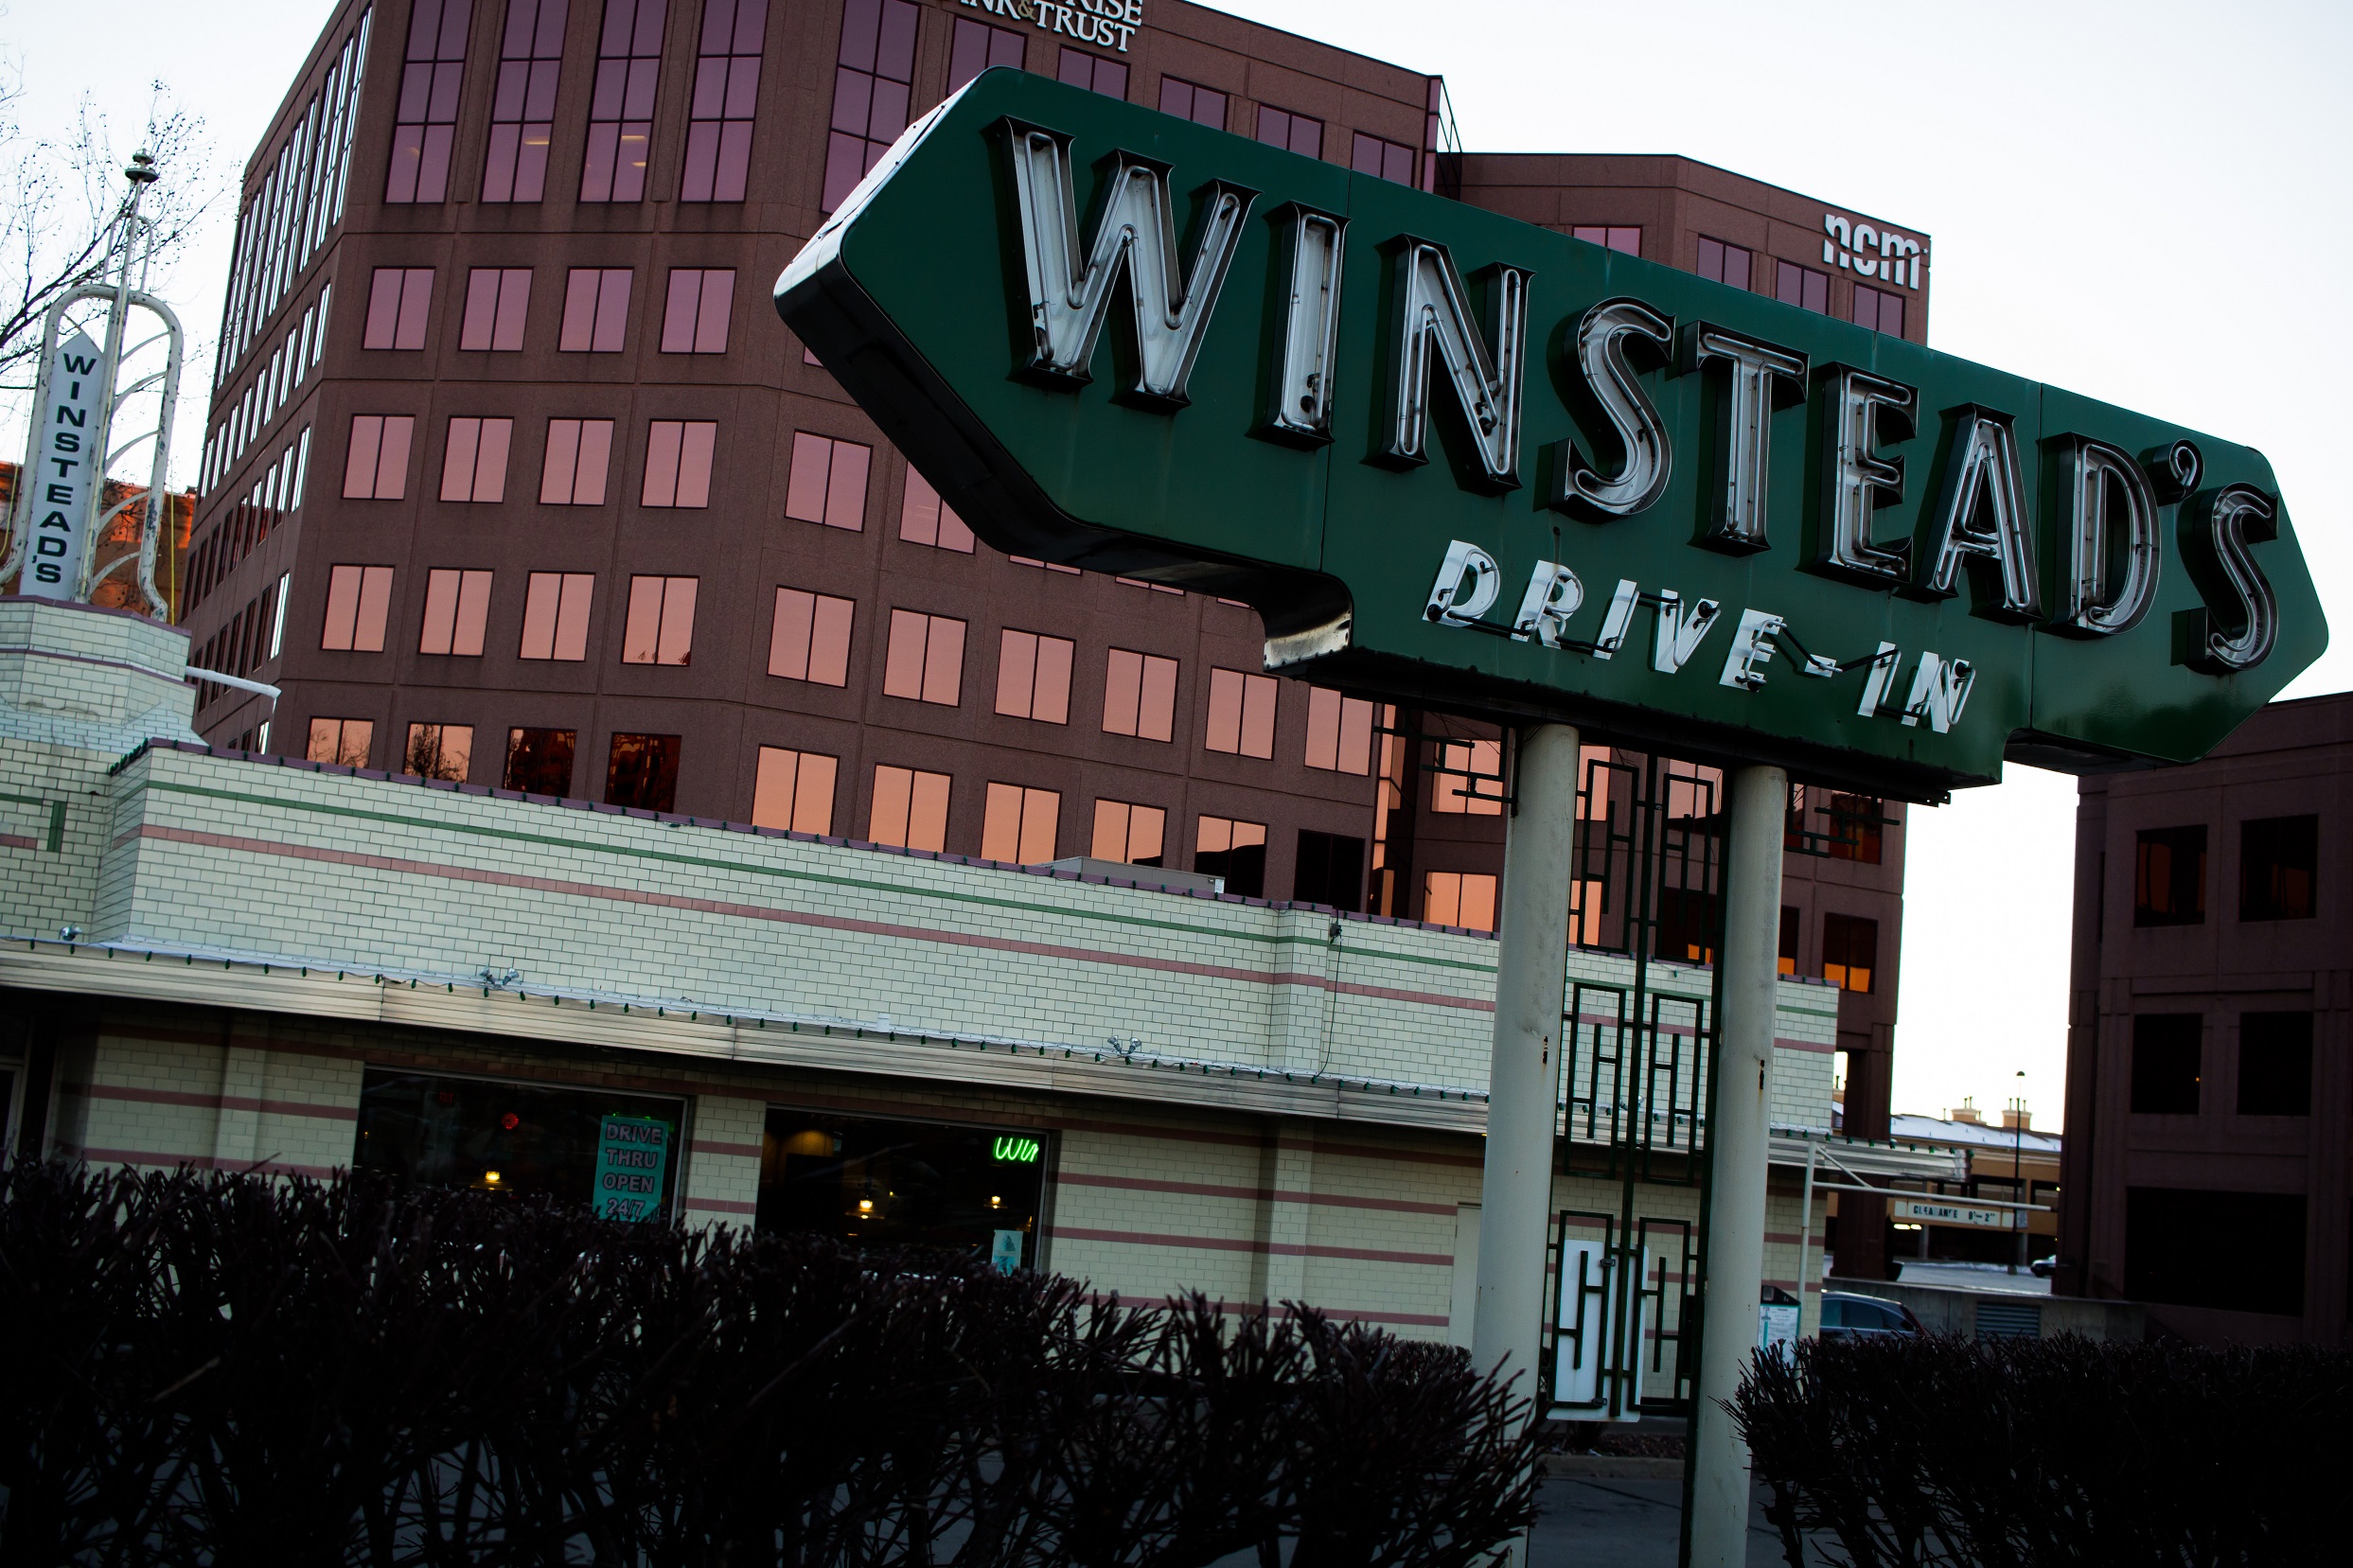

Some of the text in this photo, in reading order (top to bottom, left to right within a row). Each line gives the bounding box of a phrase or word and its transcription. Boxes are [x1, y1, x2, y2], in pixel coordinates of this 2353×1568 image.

[1034, 1, 1136, 52] TRUST
[1823, 214, 1920, 290] ncm
[981, 115, 2278, 675] WINSTEAD'S
[31, 353, 97, 584] WINSTEAD'S
[606, 1122, 662, 1144] DRIVE
[606, 1148, 657, 1169] THRU
[603, 1172, 654, 1192] OPEN
[607, 1197, 645, 1217] 24/7
